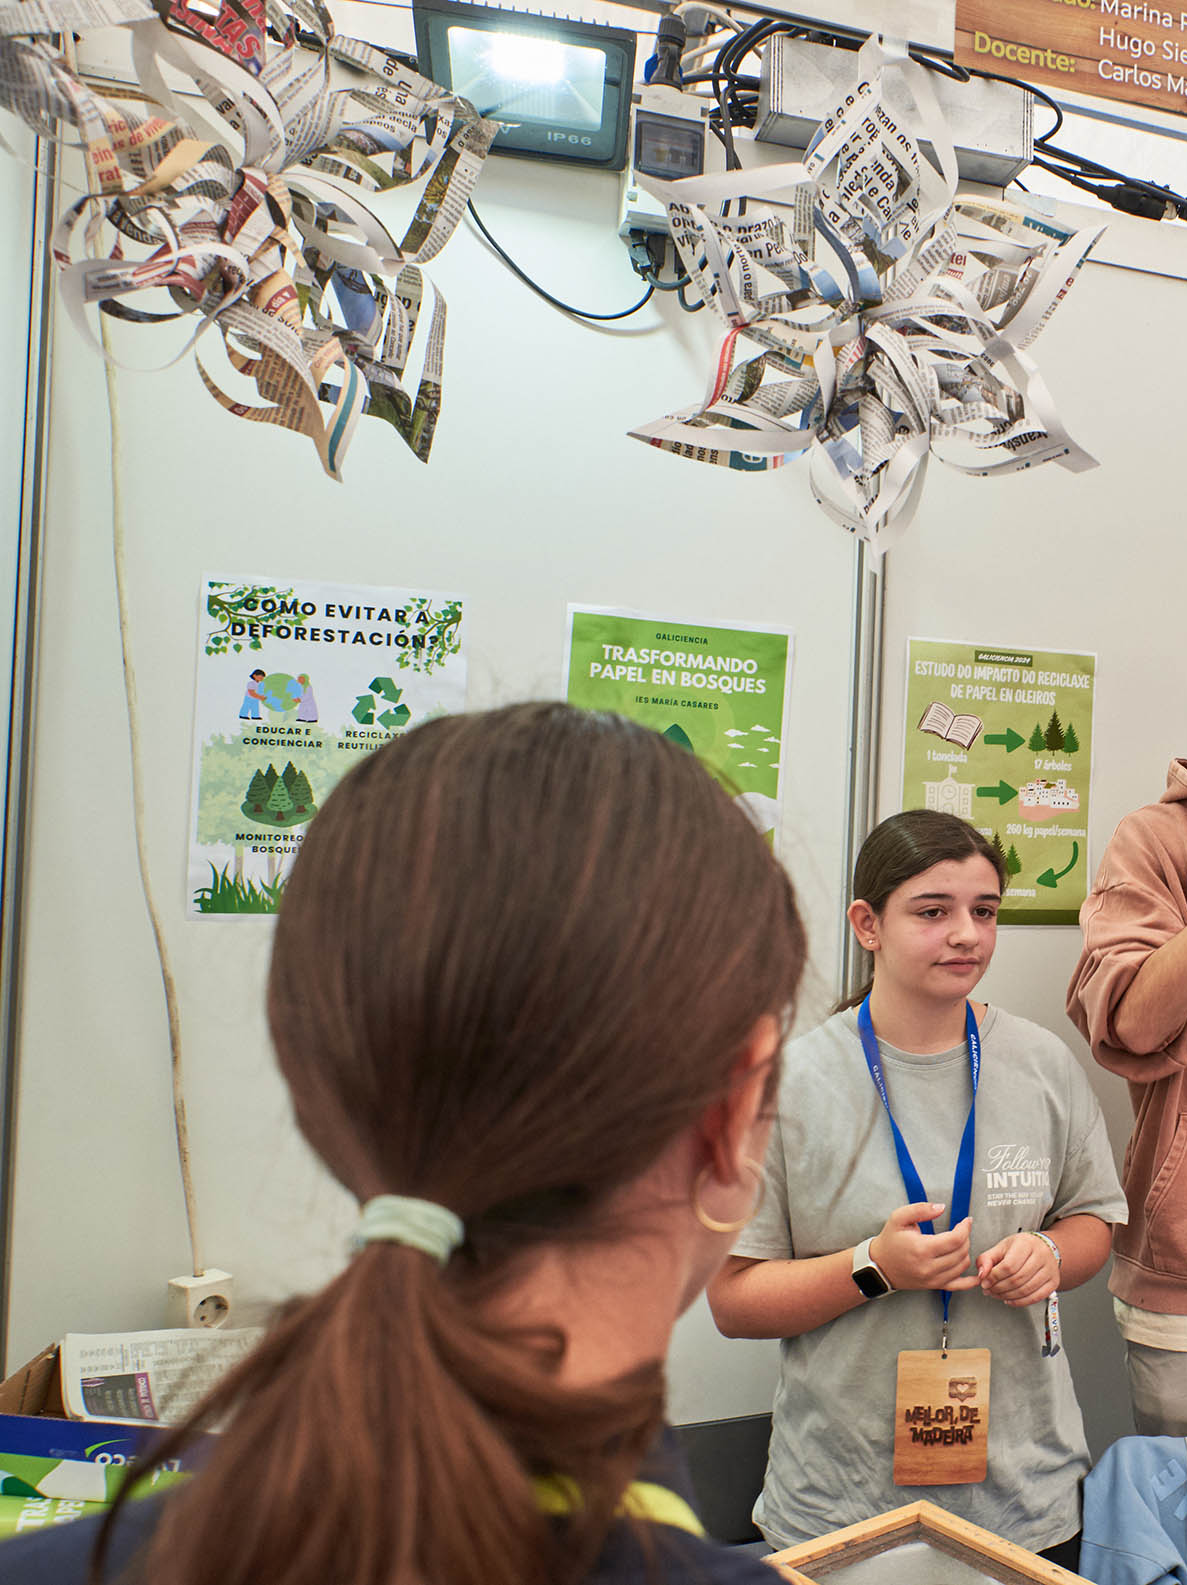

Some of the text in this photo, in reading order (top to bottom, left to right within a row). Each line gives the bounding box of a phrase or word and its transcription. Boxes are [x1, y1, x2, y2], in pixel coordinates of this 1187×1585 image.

[1100, 0, 1173, 28] Marina
[973, 31, 1076, 72] Docente:
[1099, 28, 1156, 60] Hugo
[1098, 59, 1161, 89] Carlos
[546, 131, 592, 147] IP66
[243, 598, 430, 625] COMO EVITAR A
[231, 621, 439, 650] DEFORESTACIÓN?
[655, 632, 708, 645] GALICIENCIA
[602, 643, 758, 675] TRASFORMANDO
[589, 662, 766, 694] PAPEL EN BOSQUES
[915, 660, 1090, 689] ESTUDO DO IMPACTO DO RECICLAXE
[635, 696, 719, 710] IES MARÍA CASARES
[951, 684, 1056, 706] DE PAPEL EN OLEIROS
[256, 726, 311, 736] EDUCAR E
[242, 738, 323, 749] CONCIENCIAR
[235, 833, 305, 843] MONITOREO
[959, 1405, 981, 1424] DE
[910, 1424, 974, 1446] MADEIRA
